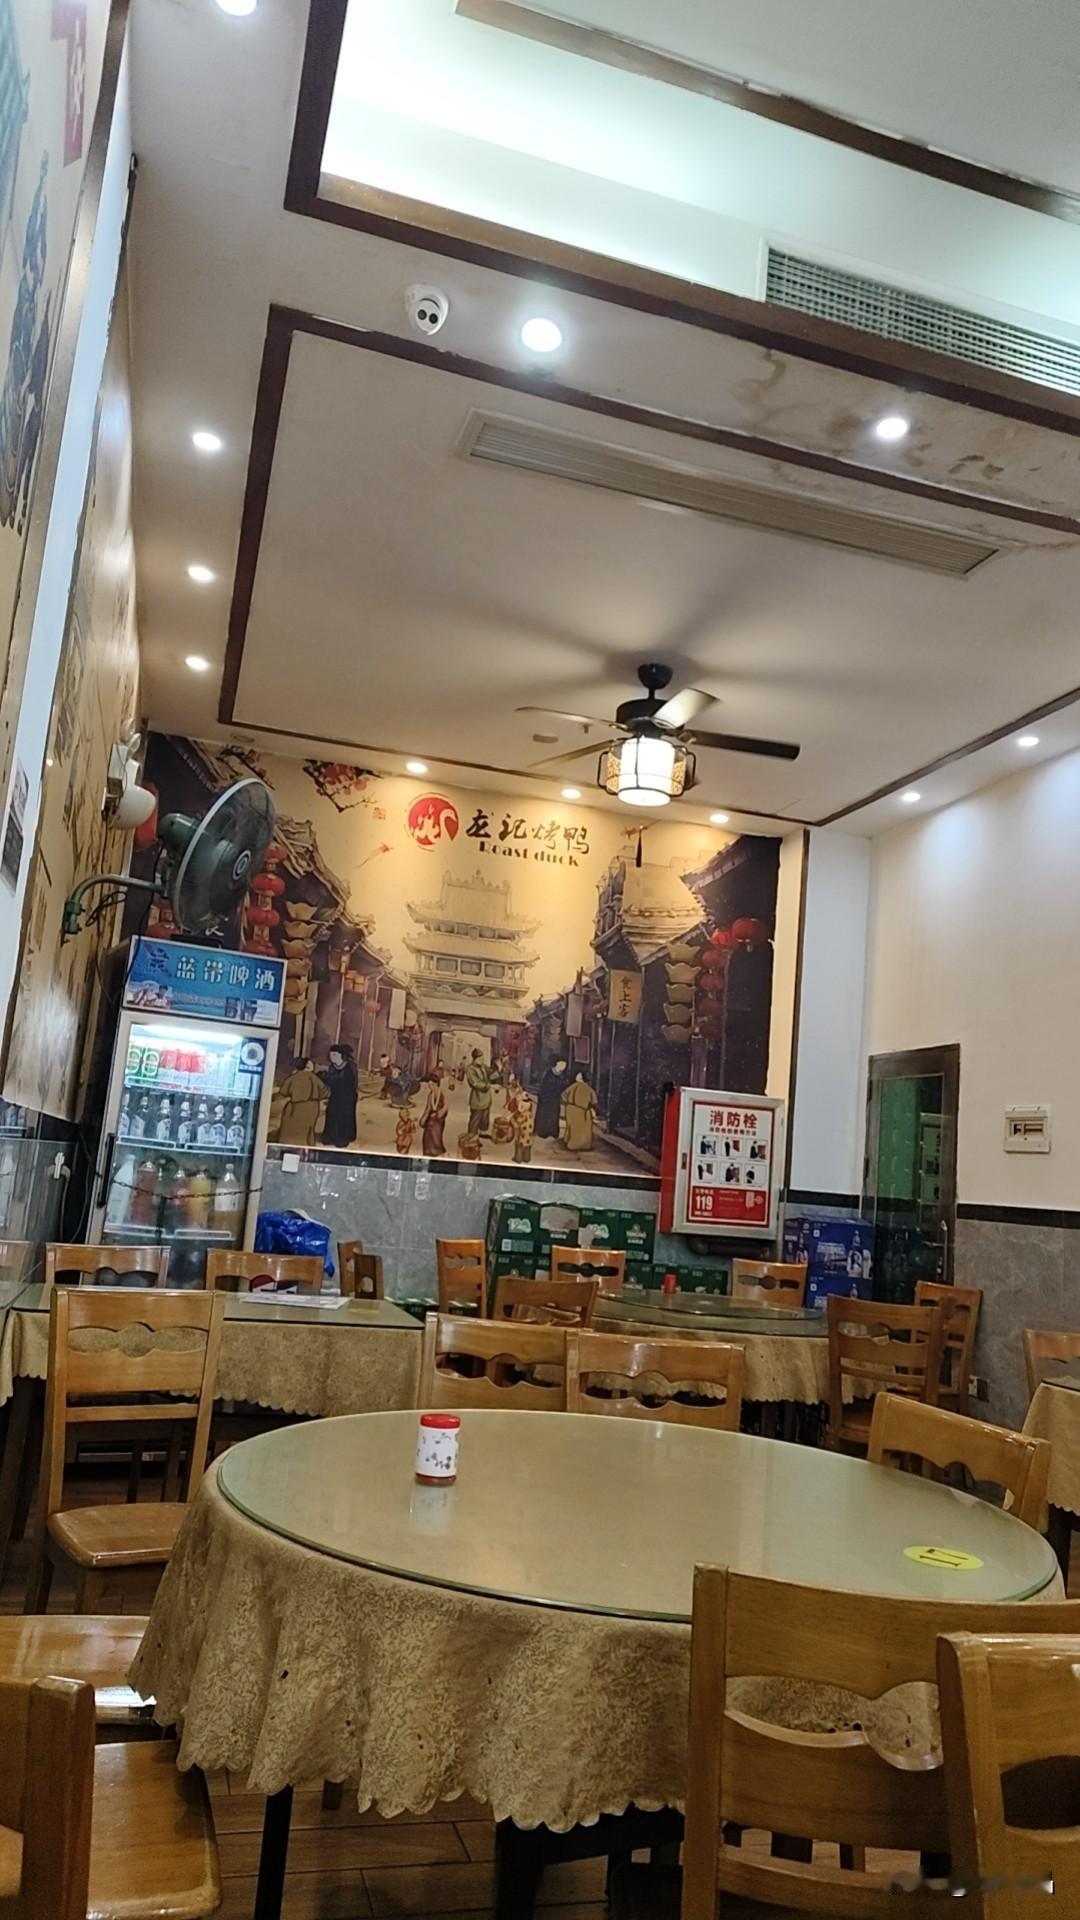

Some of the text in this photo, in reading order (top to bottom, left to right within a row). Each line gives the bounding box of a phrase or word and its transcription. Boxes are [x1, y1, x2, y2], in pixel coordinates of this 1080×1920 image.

[478, 841, 579, 867] Roast duck
[709, 1110, 758, 1129] 消防栓
[696, 1195, 713, 1211] 119
